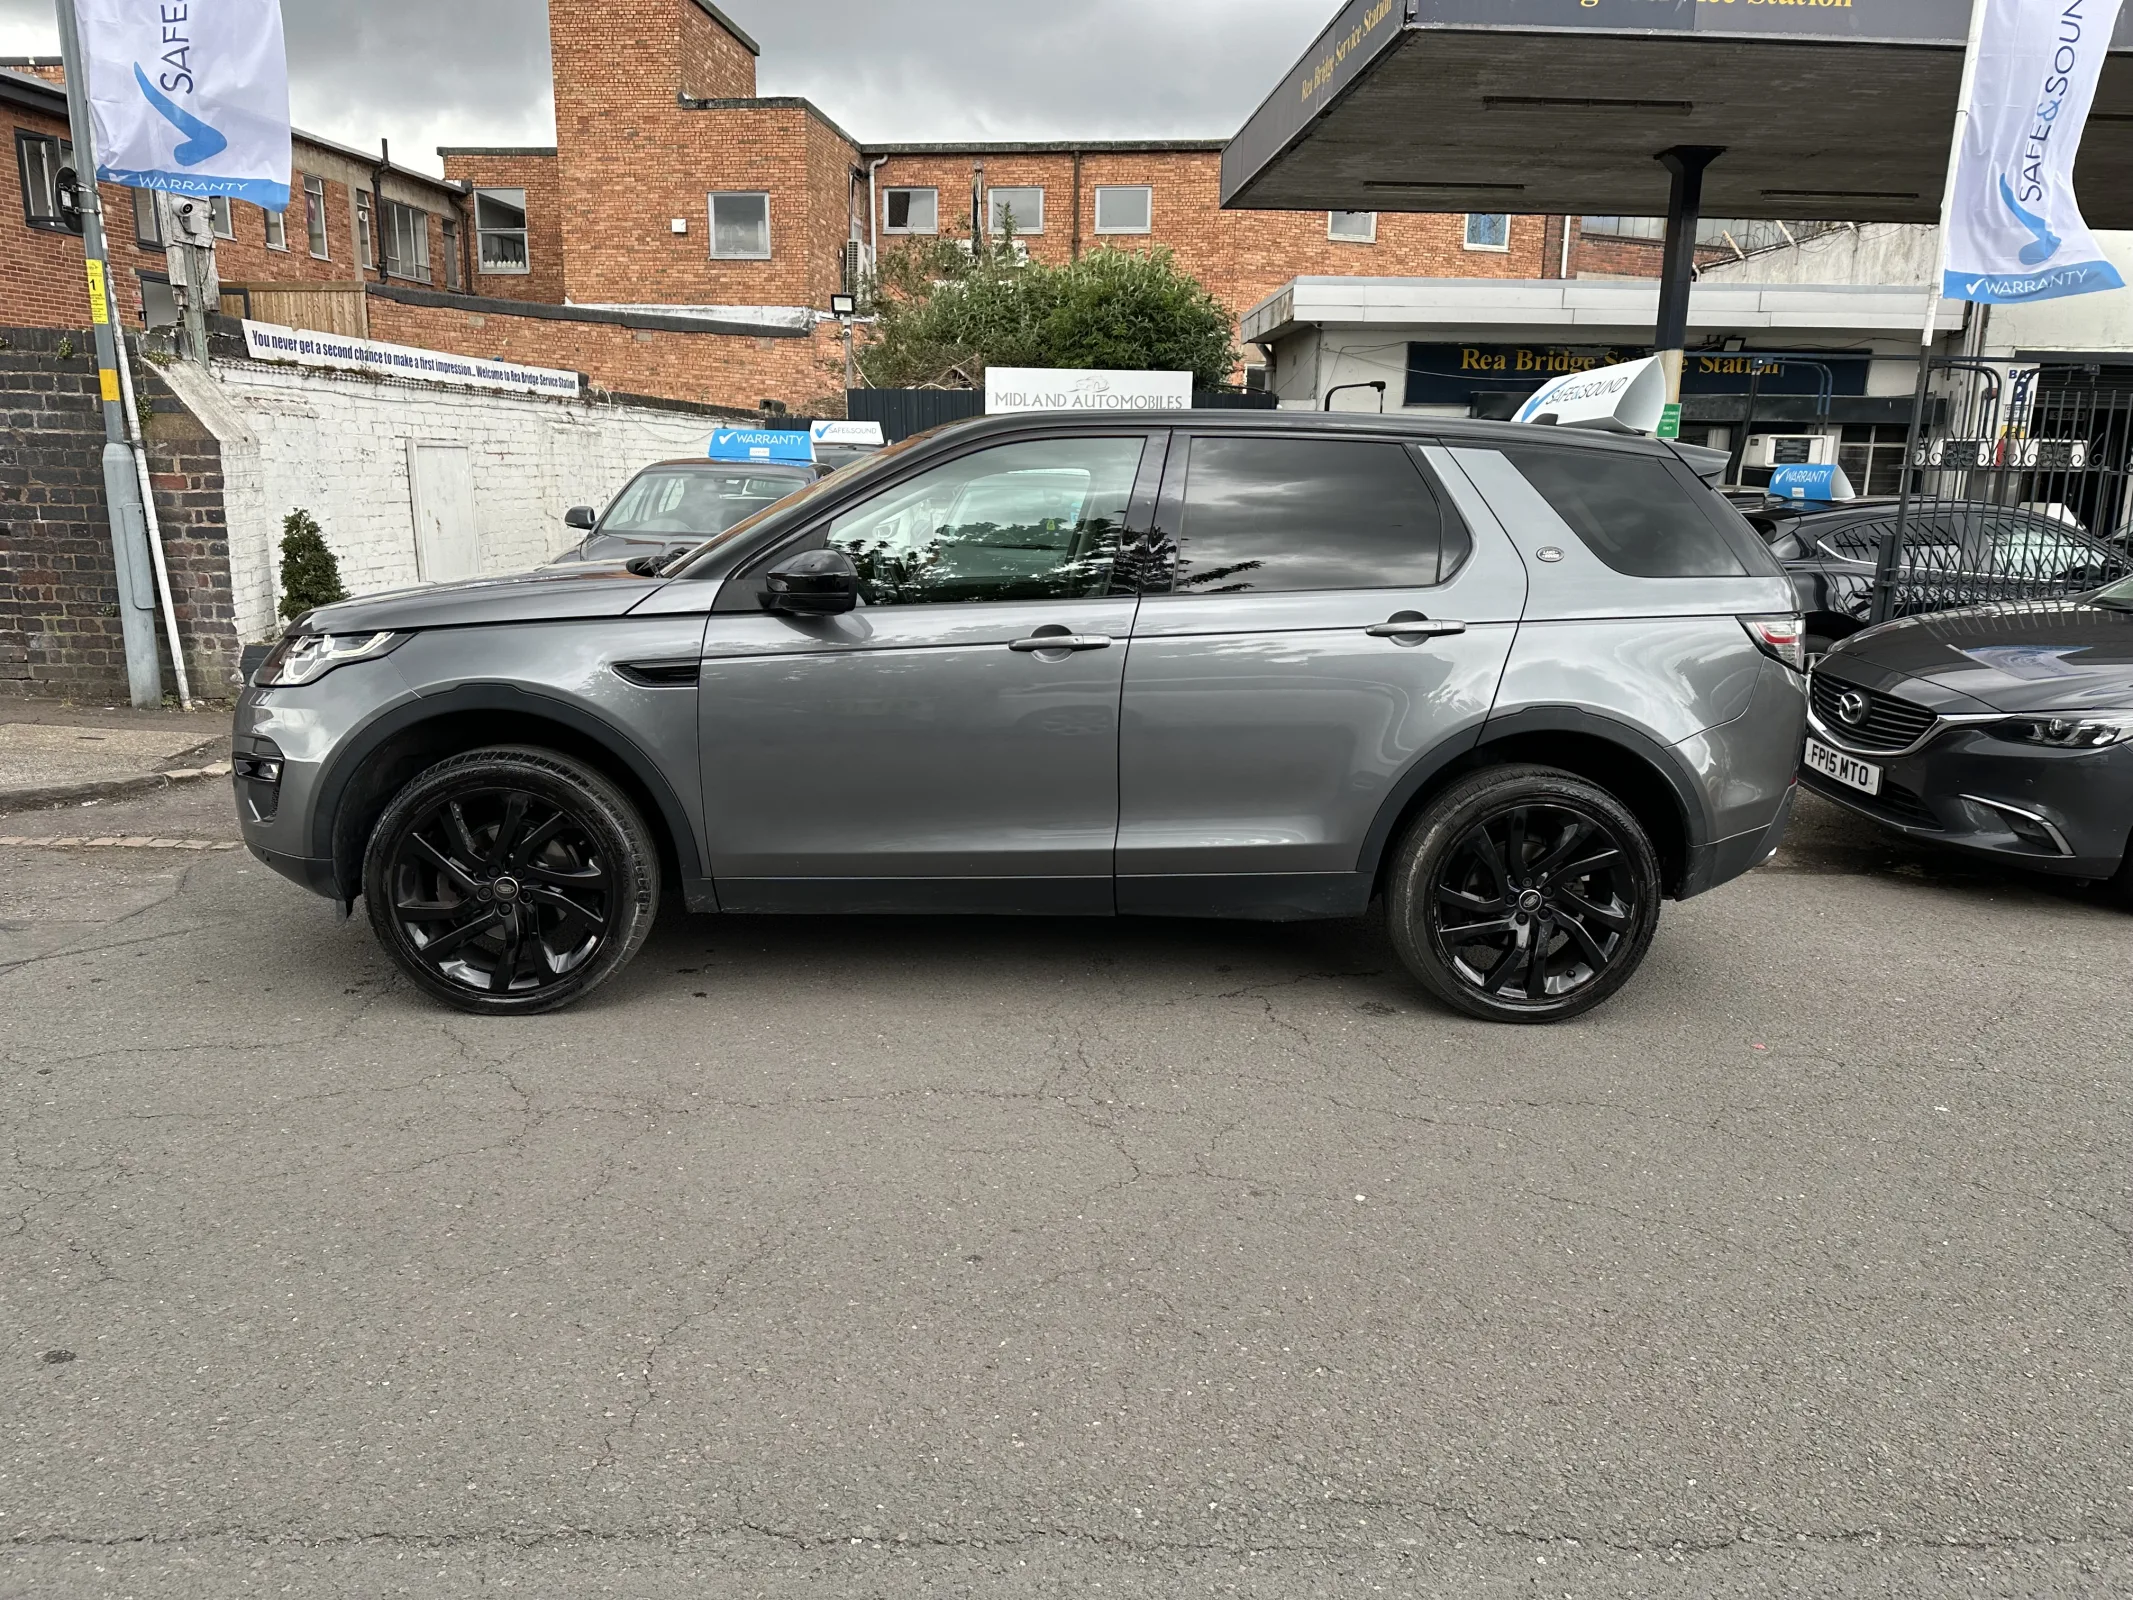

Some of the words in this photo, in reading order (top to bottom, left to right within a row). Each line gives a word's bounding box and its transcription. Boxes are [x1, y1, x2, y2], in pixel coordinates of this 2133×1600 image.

[159, 0, 194, 95] SAFE
[1335, 24, 1362, 66] Service
[138, 173, 249, 192] WARRANTY
[89, 278, 96, 291] 1
[1985, 268, 2088, 295] WARRANTY
[251, 329, 270, 347] You
[271, 336, 298, 352] never
[299, 339, 314, 354] get
[316, 342, 321, 354] a
[322, 344, 353, 359] second
[354, 347, 383, 363] chance
[384, 351, 392, 364] to
[393, 353, 414, 368] make
[414, 358, 420, 369] a
[420, 357, 435, 371] first
[476, 365, 504, 381] Welcome
[504, 370, 510, 381] to
[521, 371, 539, 386] Bridge
[539, 375, 558, 388] Service
[558, 376, 576, 390] Station
[1460, 348, 1506, 370] Rea
[1514, 349, 1596, 374] Bridge
[994, 391, 1067, 407] MIDLAND
[1071, 394, 1183, 410] AUTOMOBILES
[1545, 376, 1628, 405] SAFE&SOUND
[736, 433, 804, 446] WARRANTY
[828, 426, 877, 435] SAFE&SOUND
[1785, 470, 1830, 483] WARRANTY
[1811, 743, 1838, 773] FP15
[1839, 757, 1869, 786] MTO
